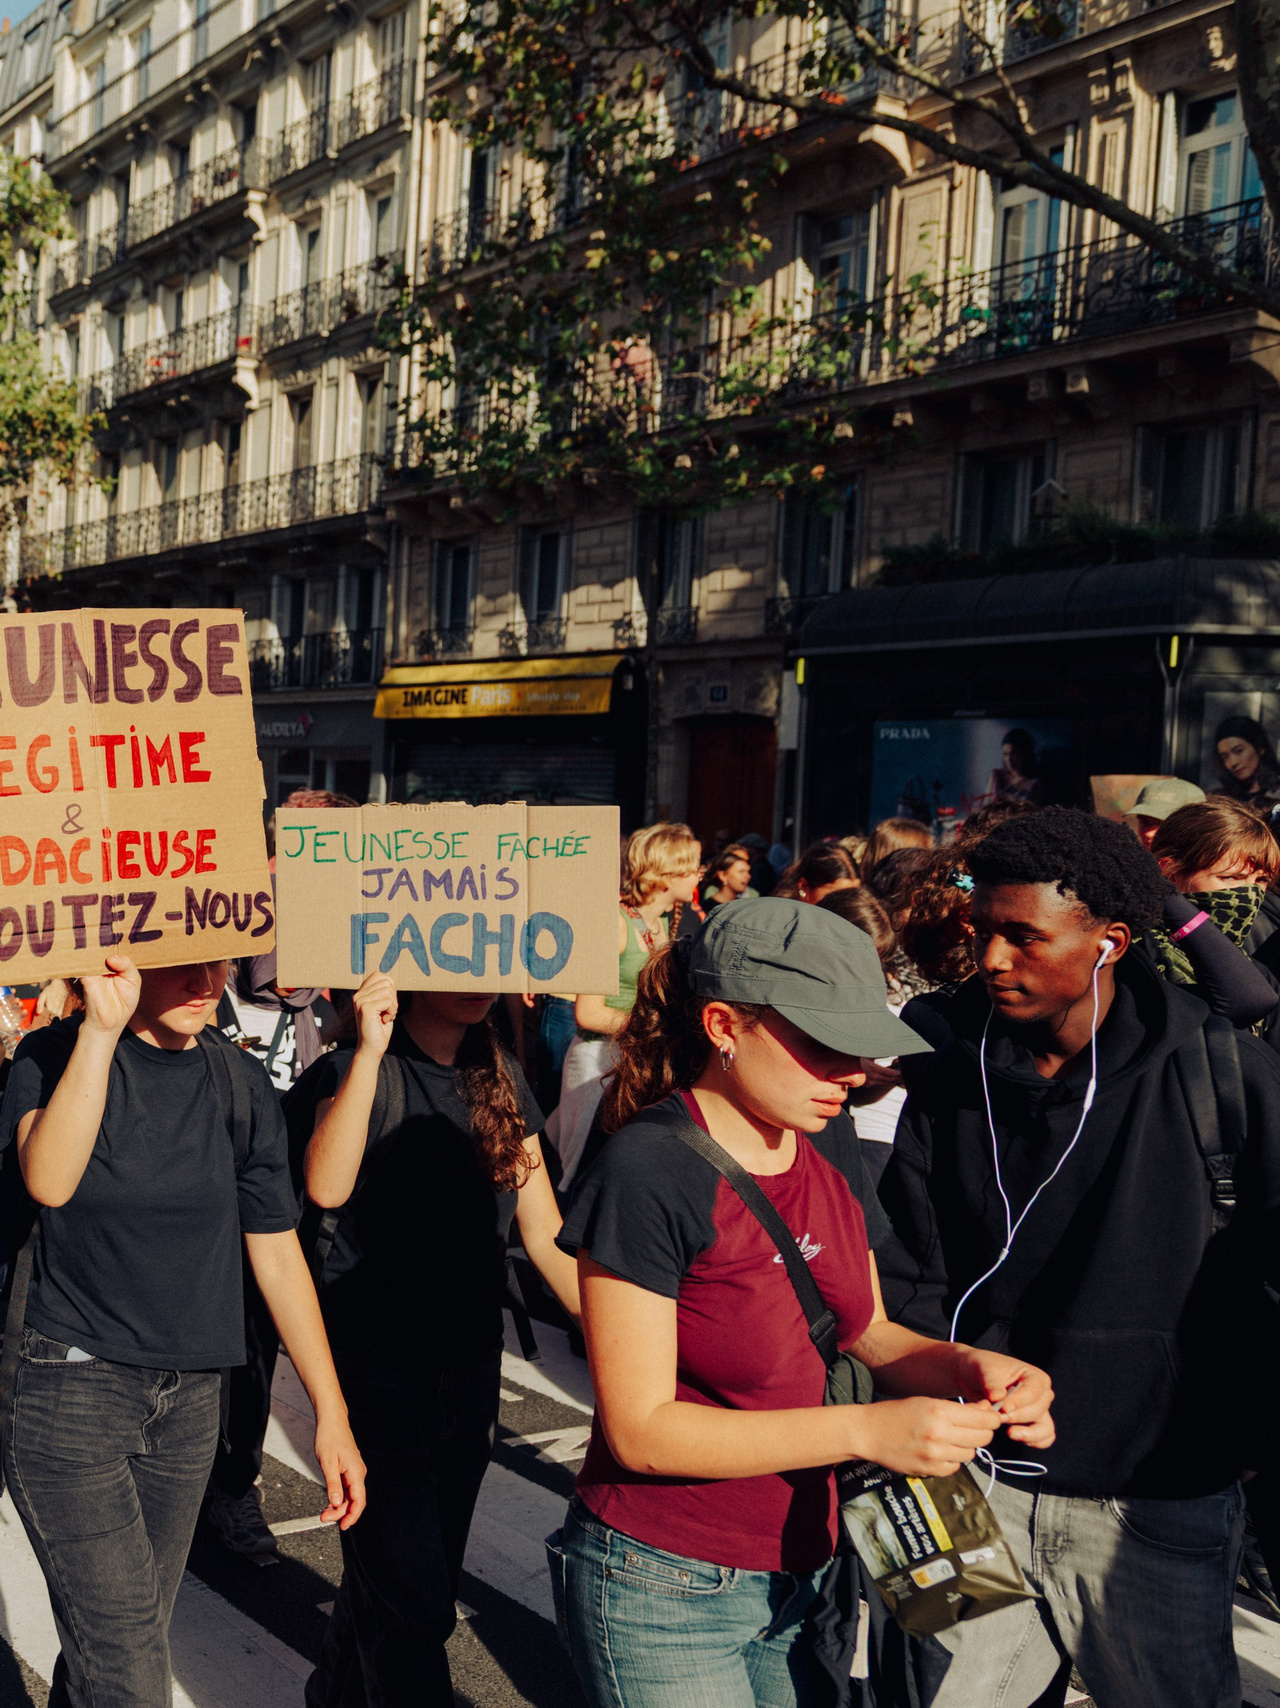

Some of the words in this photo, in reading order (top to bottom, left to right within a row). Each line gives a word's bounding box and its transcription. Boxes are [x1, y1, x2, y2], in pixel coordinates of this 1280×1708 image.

[402, 688, 468, 708] IMAGINE
[470, 684, 512, 706] Paris
[879, 727, 931, 740] PRADA
[60, 802, 84, 835] &
[281, 825, 469, 864] JEUNESSE
[497, 828, 591, 864] FACHÉE
[349, 910, 574, 982] FACHO
[884, 1484, 907, 1525] bouche
[901, 1495, 928, 1536] artères
[901, 1524, 924, 1561] Fumer
[919, 1536, 936, 1556] vos
